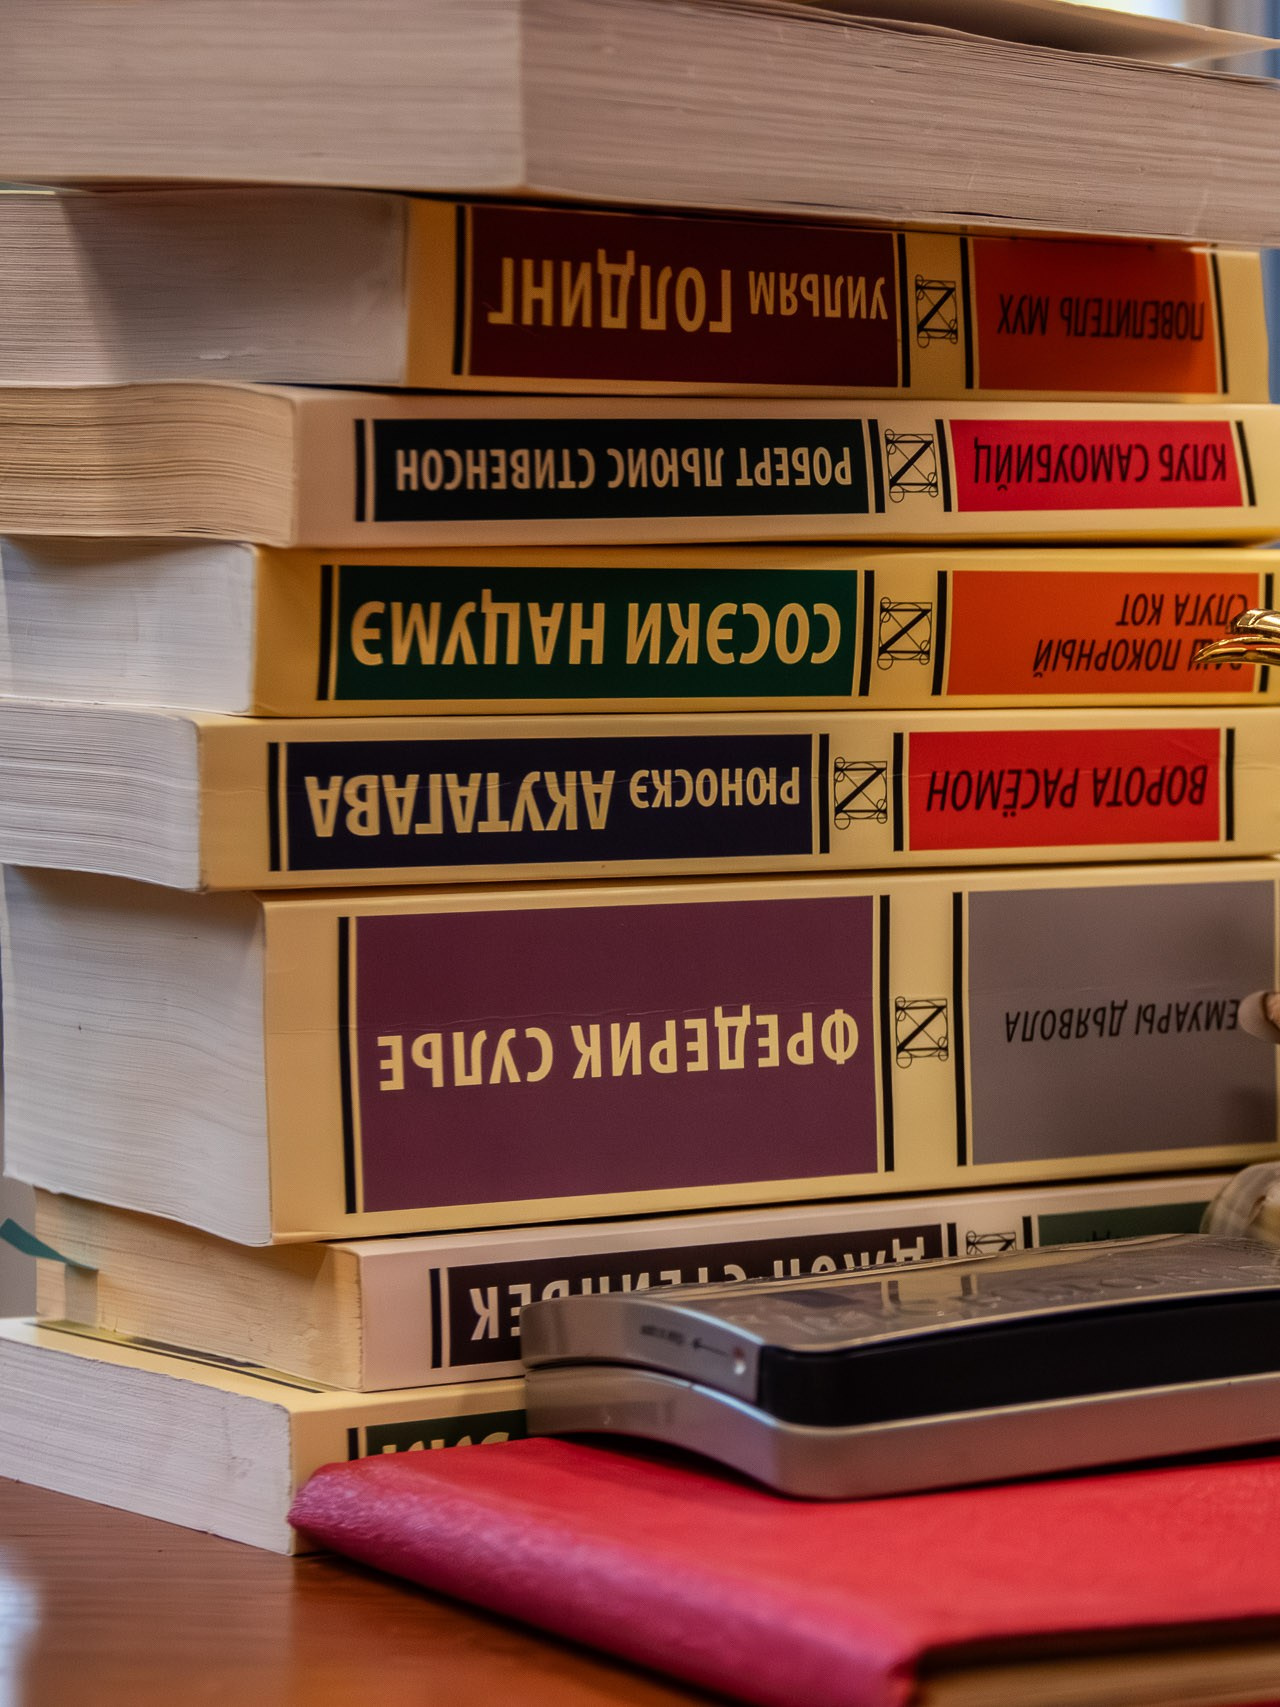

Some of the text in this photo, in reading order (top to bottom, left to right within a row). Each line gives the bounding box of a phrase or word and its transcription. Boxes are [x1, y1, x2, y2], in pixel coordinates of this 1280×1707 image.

[488, 250, 887, 332] УИЛЬЯМ ГОЛДИНГ
[998, 294, 1205, 340] ПОВЕЛИТЕЛЬ МУХ
[397, 447, 851, 490] РОБЕРТ ЛЬЮИС СТИВЕНСОН
[974, 437, 1226, 491] КЛУБ САМОУБИЙЦ
[352, 589, 840, 665] СОСЭКИ НАЦУМЭ
[1116, 594, 1164, 626] КОТ
[1033, 639, 1181, 677] ПОКОРНЫЙ
[305, 767, 799, 837] РЮНОСКЭ АКУТАГАВА
[927, 765, 1207, 817] ВОРОТА РАСЁМОН
[1006, 1000, 1240, 1042] ЕМУАРЫ ДЬЯВОЛА
[378, 1005, 858, 1090] ФРЕДЕРИК СУЛЬЕ
